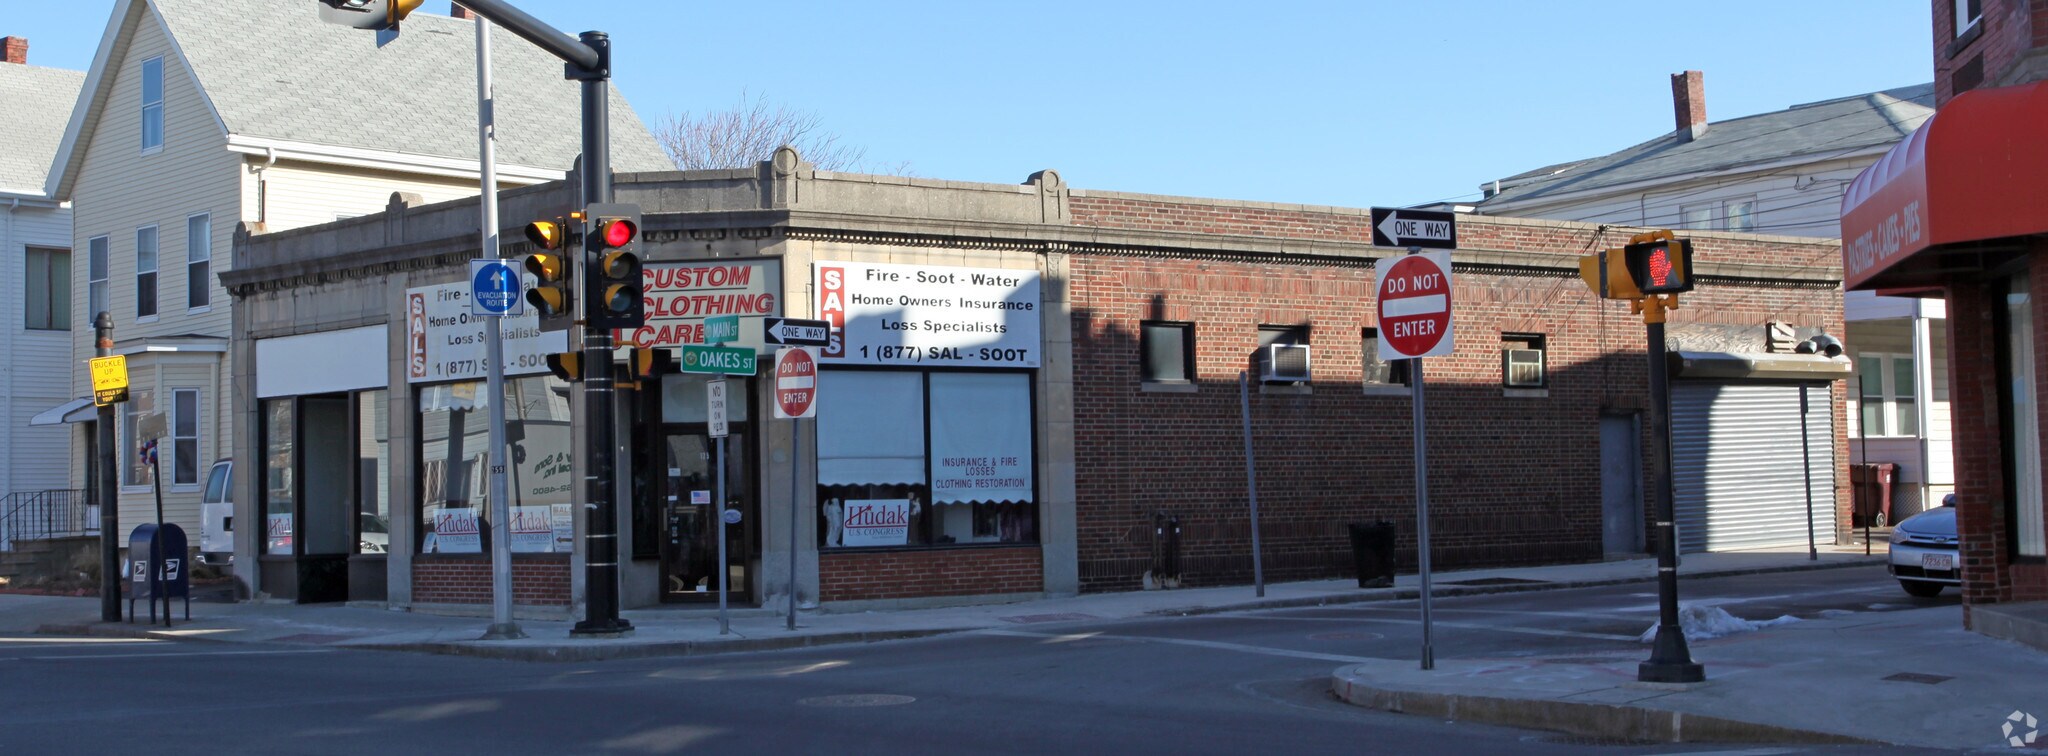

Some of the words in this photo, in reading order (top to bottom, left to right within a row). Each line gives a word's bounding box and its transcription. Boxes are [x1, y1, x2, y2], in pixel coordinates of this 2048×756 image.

[1395, 221, 1417, 236] ONE
[1425, 222, 1448, 237] WAY
[1848, 229, 1874, 279] PASTRIES
[1878, 212, 1899, 261] CAKES
[1904, 200, 1920, 246] PIES
[643, 265, 751, 293] CUSTOM
[866, 269, 899, 282] Fire
[917, 270, 955, 284] Soot
[971, 273, 1020, 287] Water
[1388, 278, 1406, 293] DO
[1414, 273, 1439, 290] NOT
[437, 289, 461, 302] Fire
[478, 291, 517, 299] EVACUATION
[852, 294, 893, 306] Home
[899, 295, 951, 307] Owners
[960, 297, 1033, 311] Insurance
[486, 299, 508, 307] ROUTE
[643, 293, 775, 321] CLOTHING
[824, 270, 843, 354] SALS
[429, 313, 456, 328] Home
[881, 319, 918, 331] Loss
[924, 320, 1007, 334] Specialists
[412, 296, 425, 374] SALS
[712, 323, 730, 338] MAIN
[731, 325, 738, 336] ST
[782, 326, 800, 337] ONE
[805, 328, 824, 338] WAY
[1394, 319, 1435, 338] ENTER
[448, 331, 473, 346] Loss
[632, 325, 704, 349] CARE
[519, 353, 548, 367] SOO
[700, 351, 740, 368] OAKES
[743, 358, 753, 369] ST
[860, 347, 868, 358] 1
[876, 346, 922, 362] (877)
[928, 347, 963, 360] SAL
[980, 348, 1027, 362] SOOT
[94, 360, 121, 369] BUCKLE
[436, 364, 441, 375] 1
[446, 360, 477, 378] (877)
[782, 363, 793, 373] DO
[796, 361, 811, 372] NOT
[713, 386, 721, 397] NO
[784, 392, 807, 404] ENTER
[711, 401, 723, 409] TURN
[942, 457, 987, 467] INSURANCE
[992, 457, 997, 467] &
[1001, 457, 1018, 467] FIRE
[965, 466, 995, 476] LOSSES
[935, 479, 972, 489] CLOTHING
[975, 478, 1025, 488] RESTORATION
[437, 513, 478, 533] Hudak
[847, 505, 907, 526] Hudak
[520, 534, 550, 542] CONGRESS
[864, 528, 904, 536] CONGRESS
